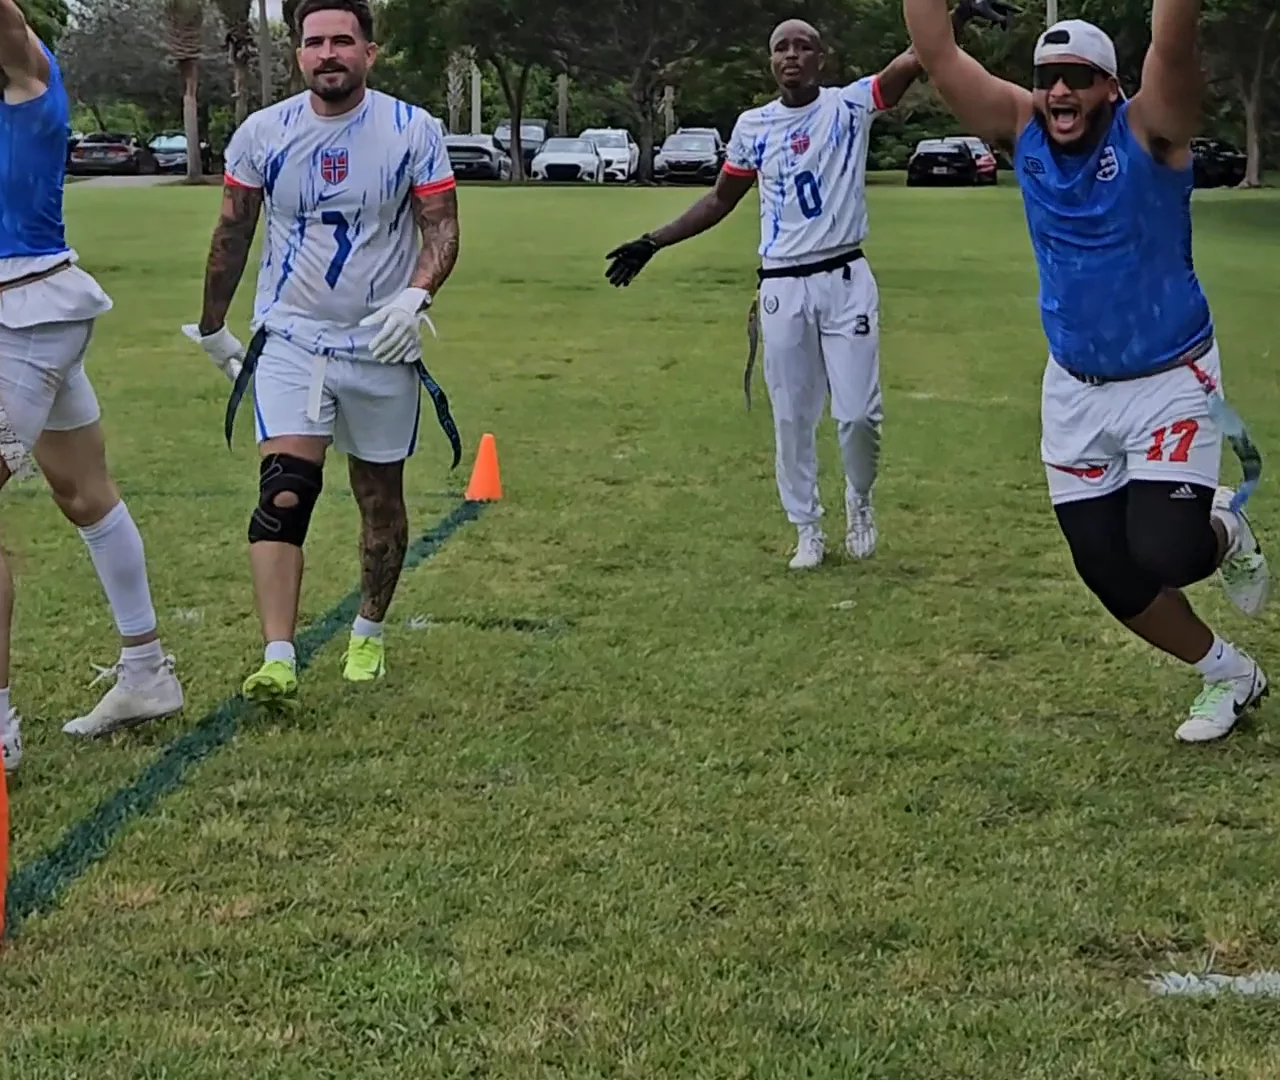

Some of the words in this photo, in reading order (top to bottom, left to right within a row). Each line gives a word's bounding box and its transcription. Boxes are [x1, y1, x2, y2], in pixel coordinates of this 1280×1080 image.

[795, 171, 823, 219] 0
[321, 211, 352, 290] 7
[855, 315, 870, 335] 3
[1147, 419, 1199, 463] 17
